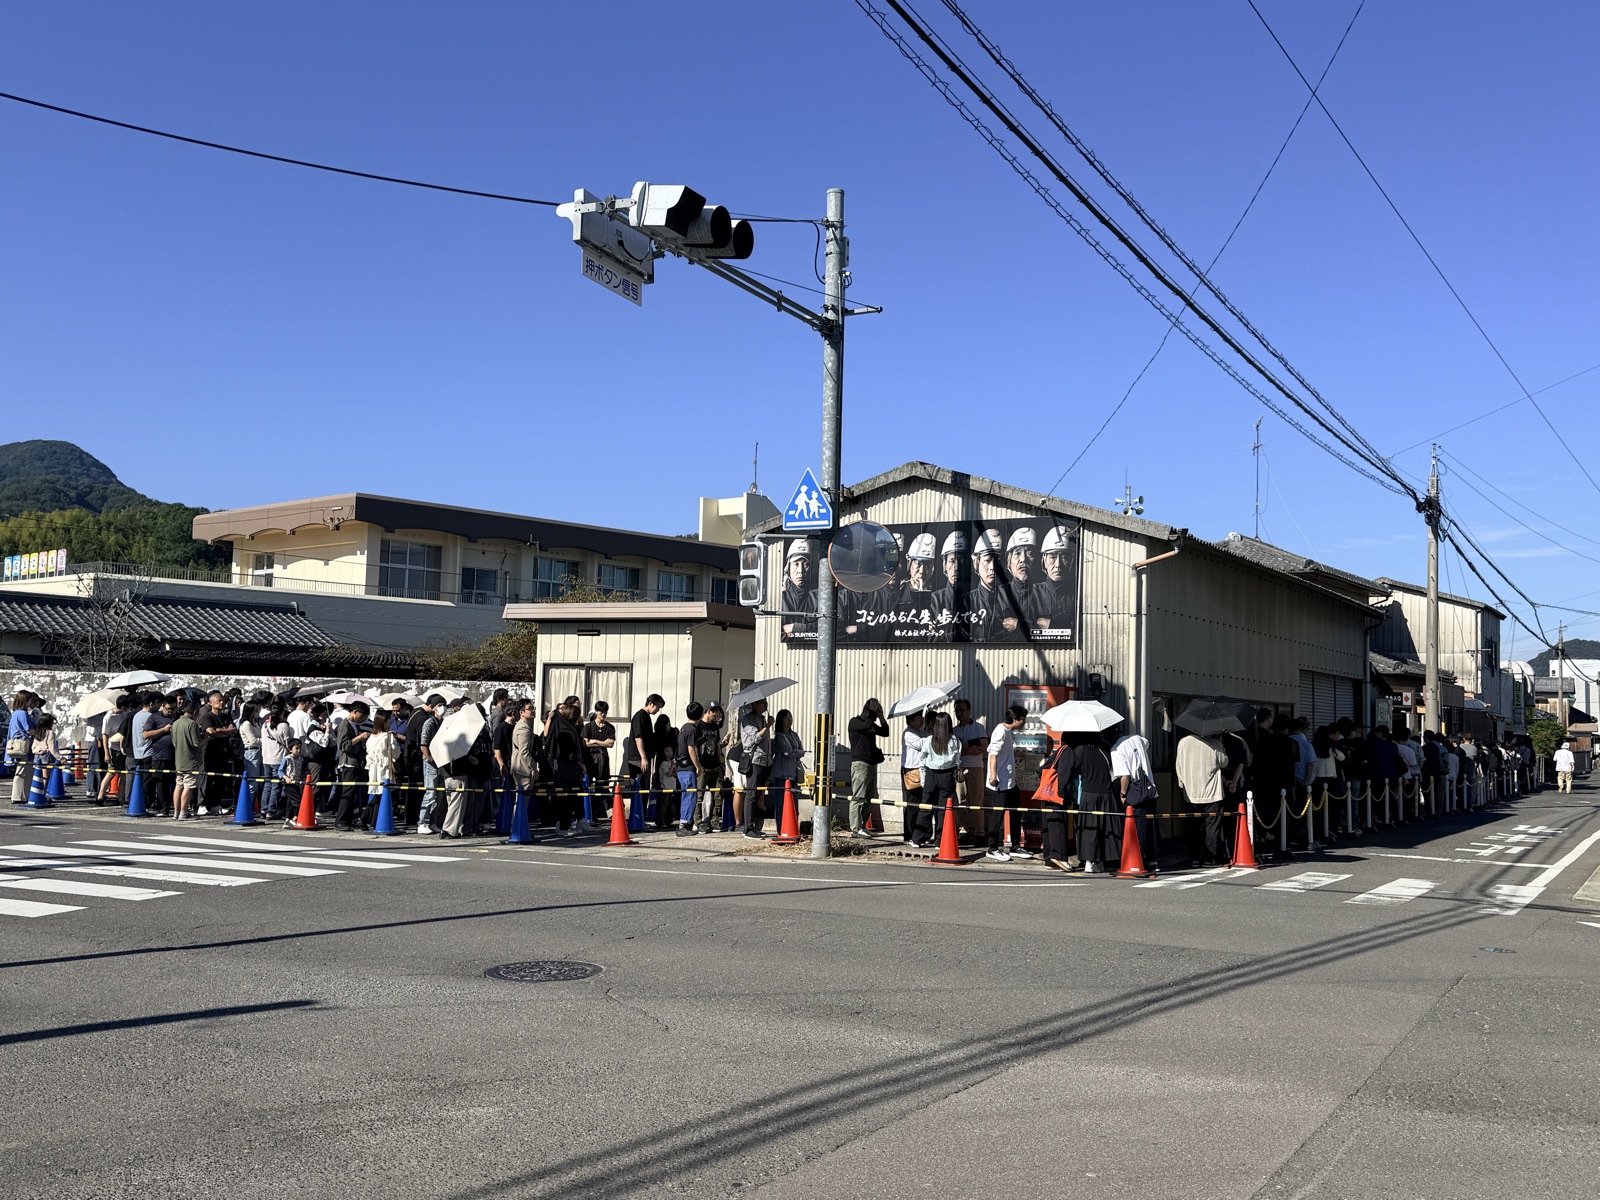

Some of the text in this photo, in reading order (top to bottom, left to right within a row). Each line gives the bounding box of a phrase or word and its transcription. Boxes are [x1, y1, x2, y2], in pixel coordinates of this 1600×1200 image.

[585, 256, 640, 301] 押ボタン信号
[894, 629, 945, 637] 株式会社サンテック
